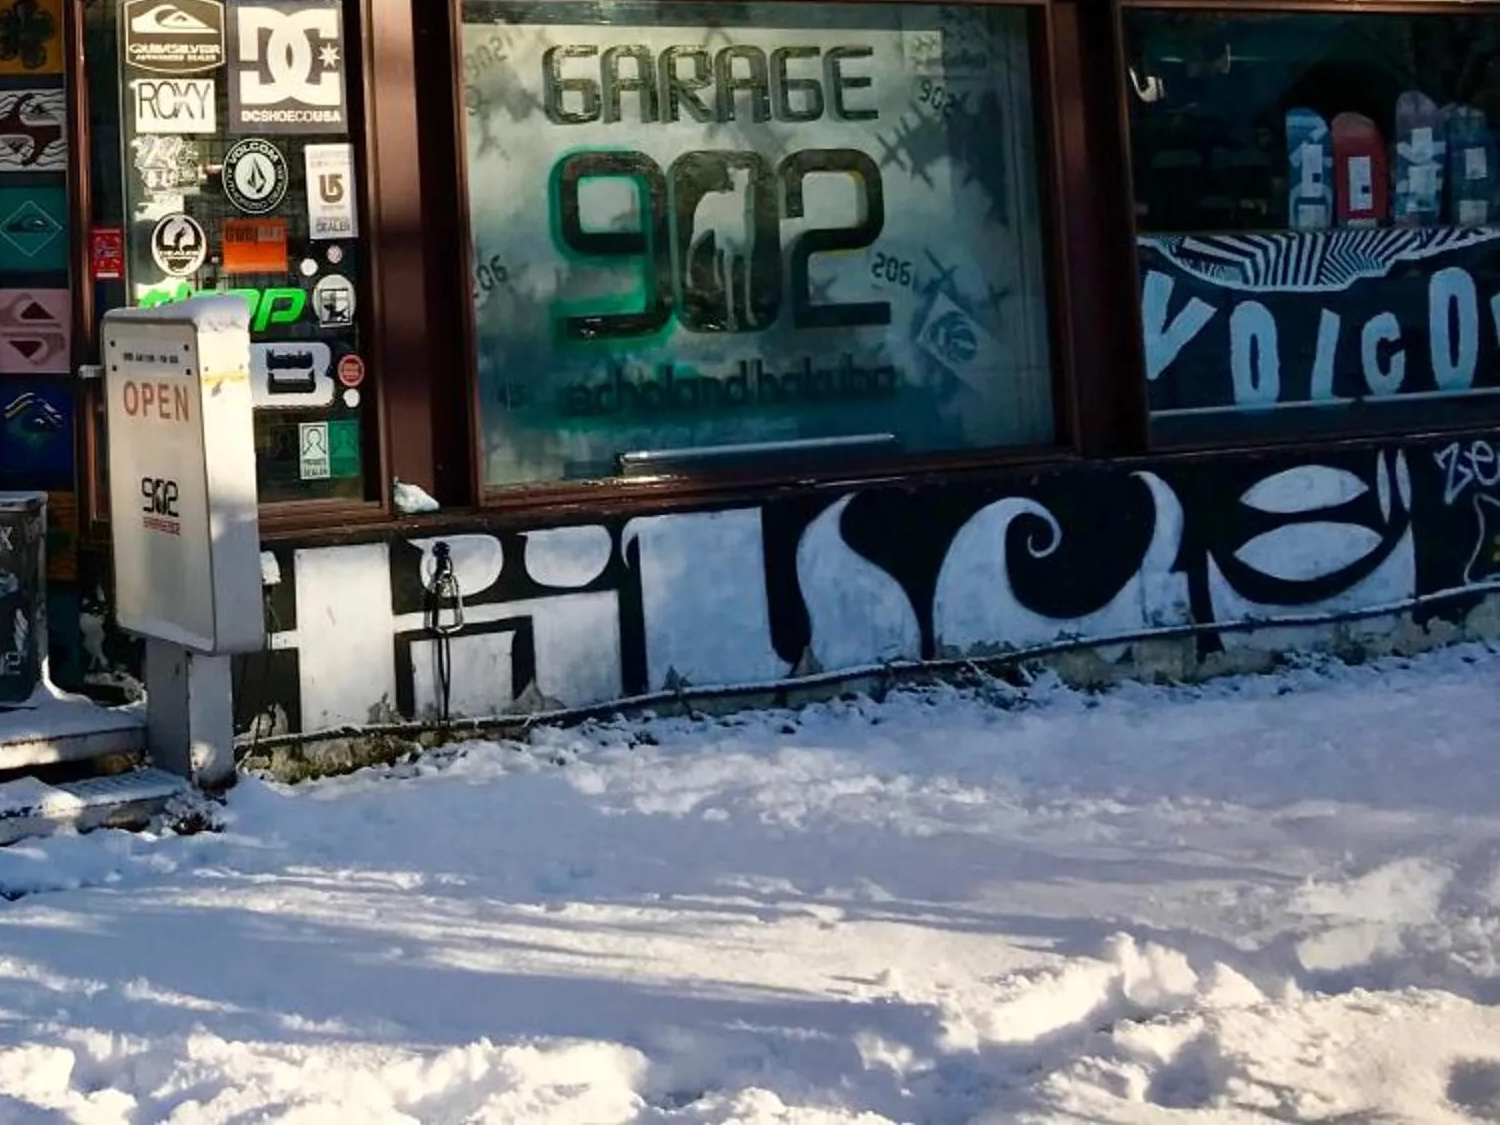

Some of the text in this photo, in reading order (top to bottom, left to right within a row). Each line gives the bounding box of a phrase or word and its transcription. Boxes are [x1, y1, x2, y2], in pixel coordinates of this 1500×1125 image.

[128, 42, 222, 55] QUIKSILVER
[138, 81, 211, 120] ROXY
[541, 43, 879, 125] GARAGE
[227, 142, 280, 165] VOLCOM
[554, 148, 891, 341] 902
[1141, 267, 1500, 412] VOLCO
[122, 379, 190, 423] OPEN
[141, 476, 180, 518] 902
